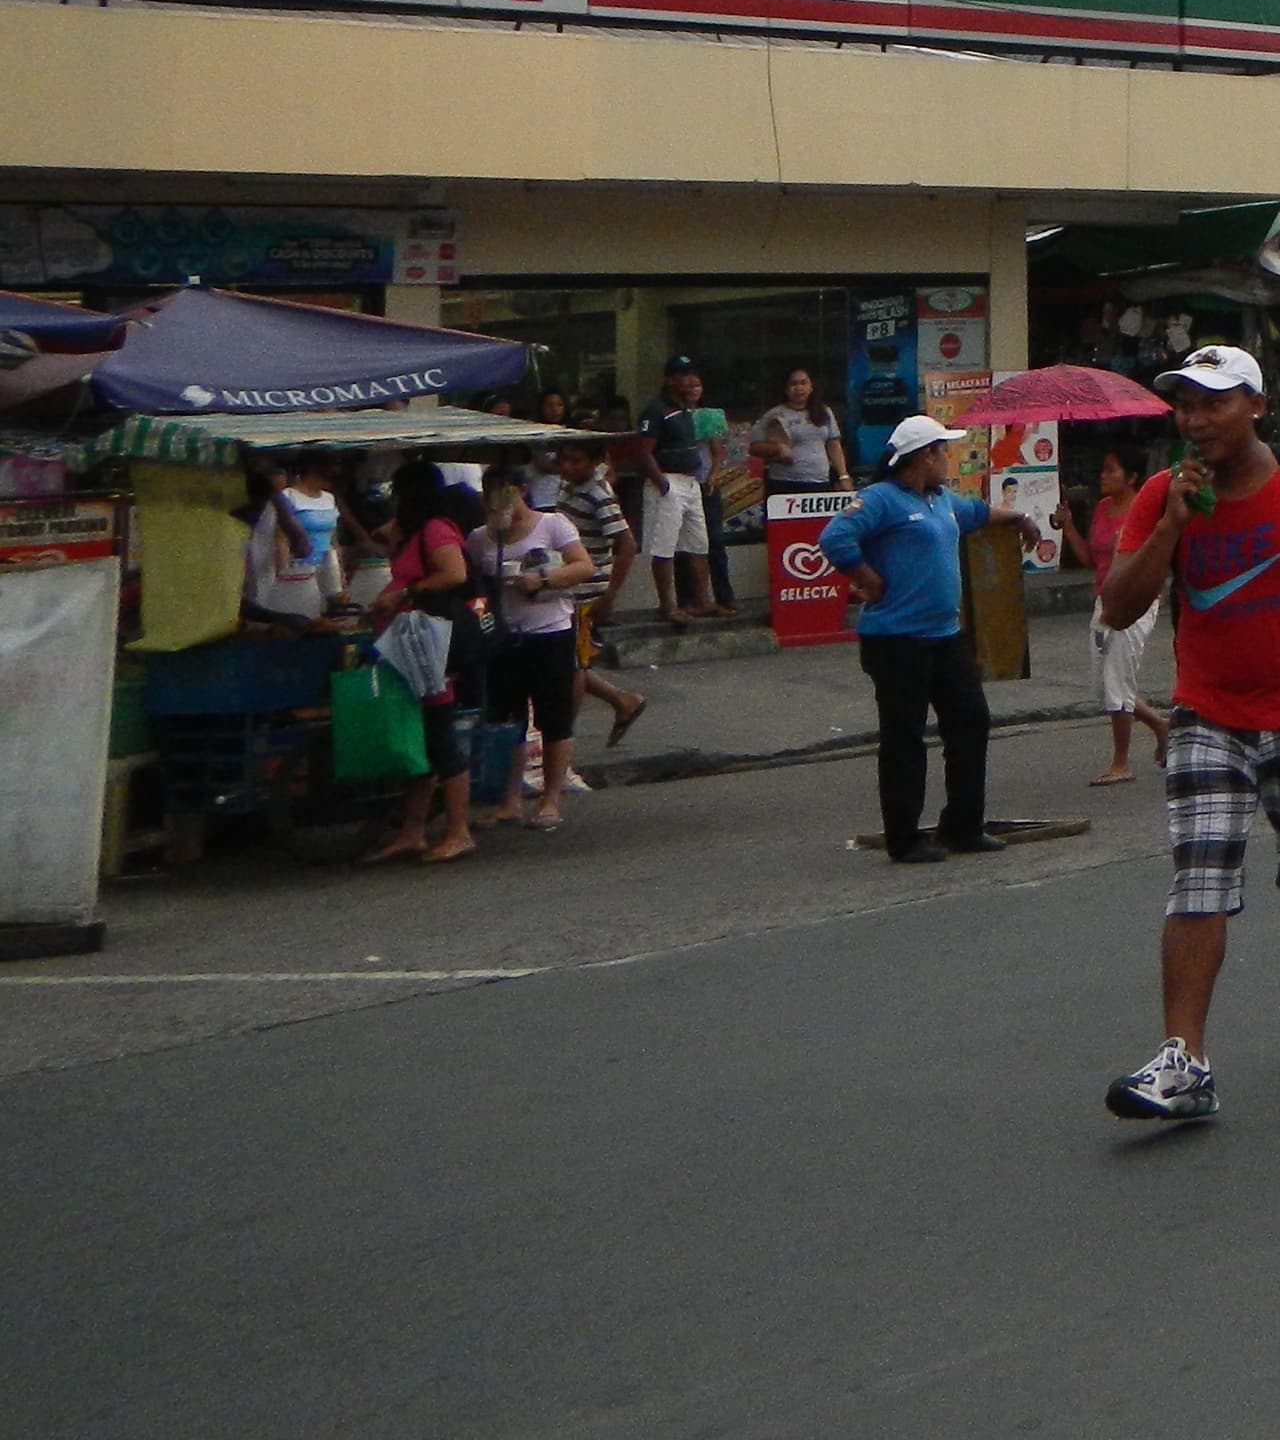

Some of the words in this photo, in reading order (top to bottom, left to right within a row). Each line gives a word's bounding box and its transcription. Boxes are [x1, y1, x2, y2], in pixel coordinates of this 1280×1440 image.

[221, 368, 448, 407] MICROMATIC
[1187, 522, 1276, 576] NIKE
[780, 586, 838, 601] SELECTA
